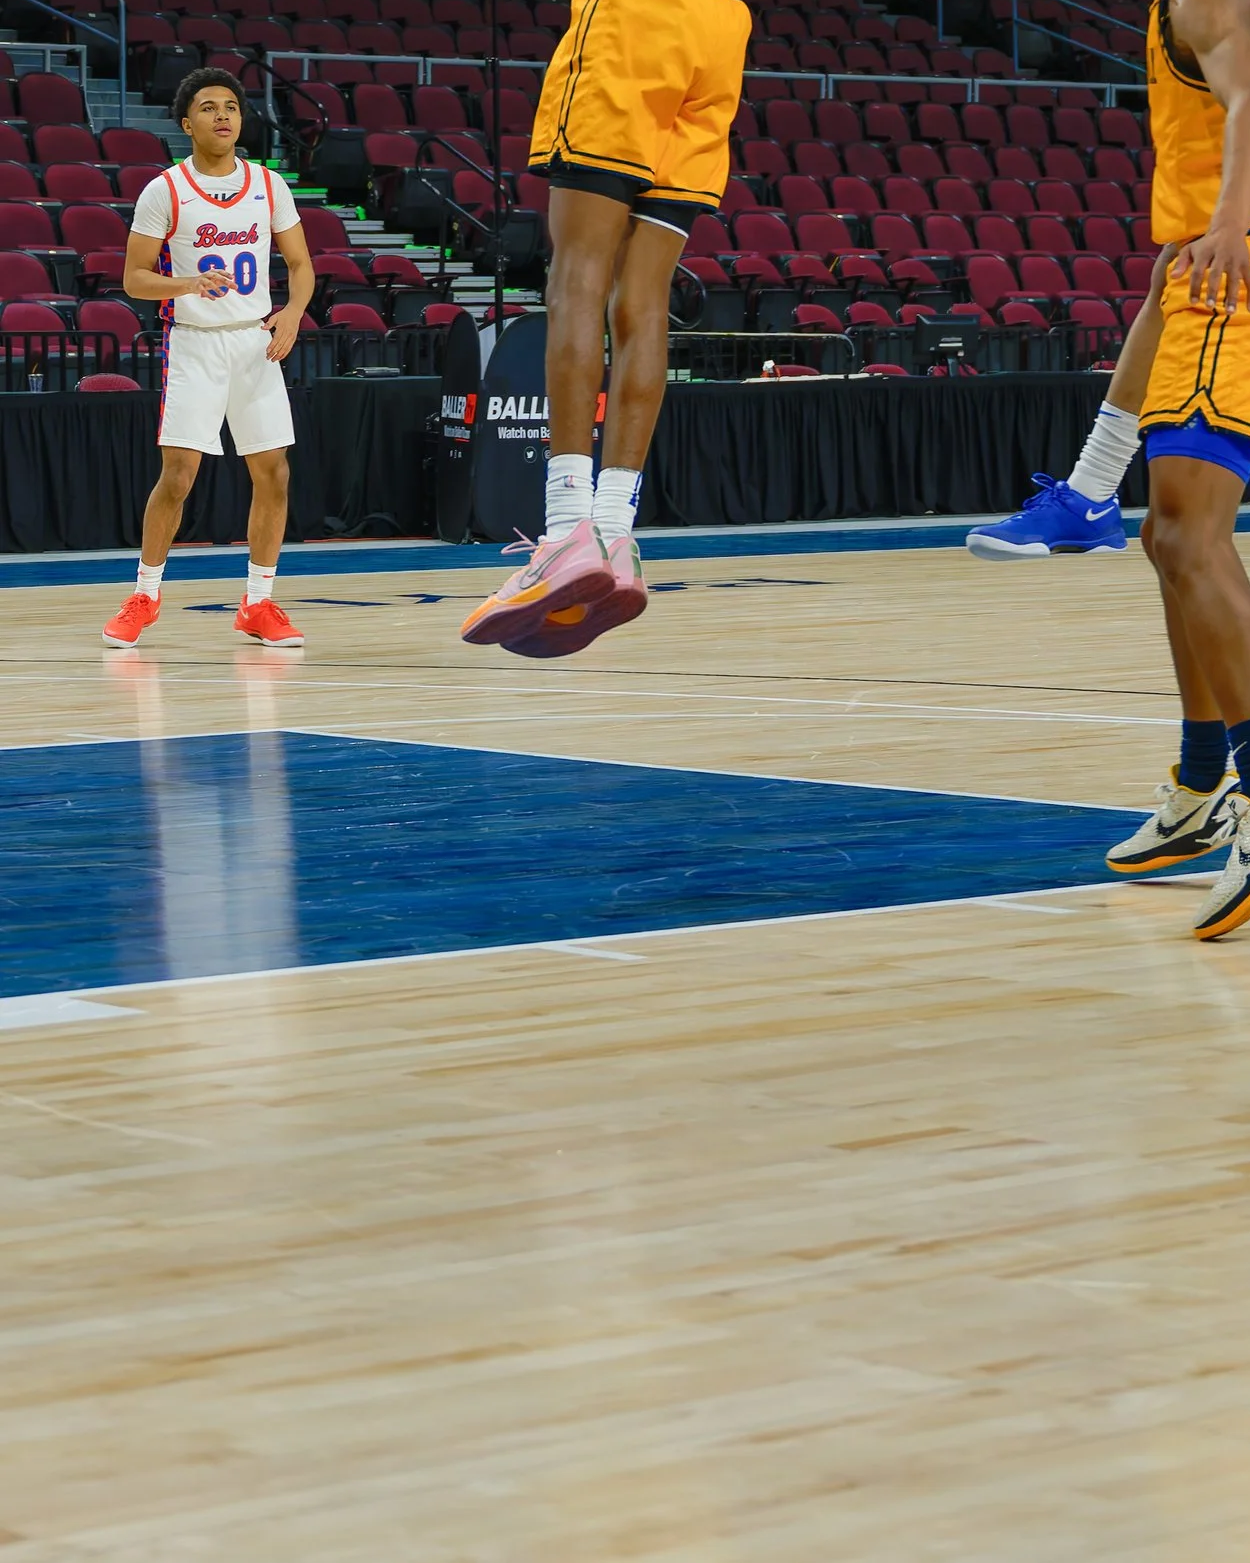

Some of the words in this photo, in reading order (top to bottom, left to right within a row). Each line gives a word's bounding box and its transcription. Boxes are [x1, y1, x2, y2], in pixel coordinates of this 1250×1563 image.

[193, 223, 259, 248] Beach
[498, 427, 527, 439] Watch
[527, 430, 539, 439] on
